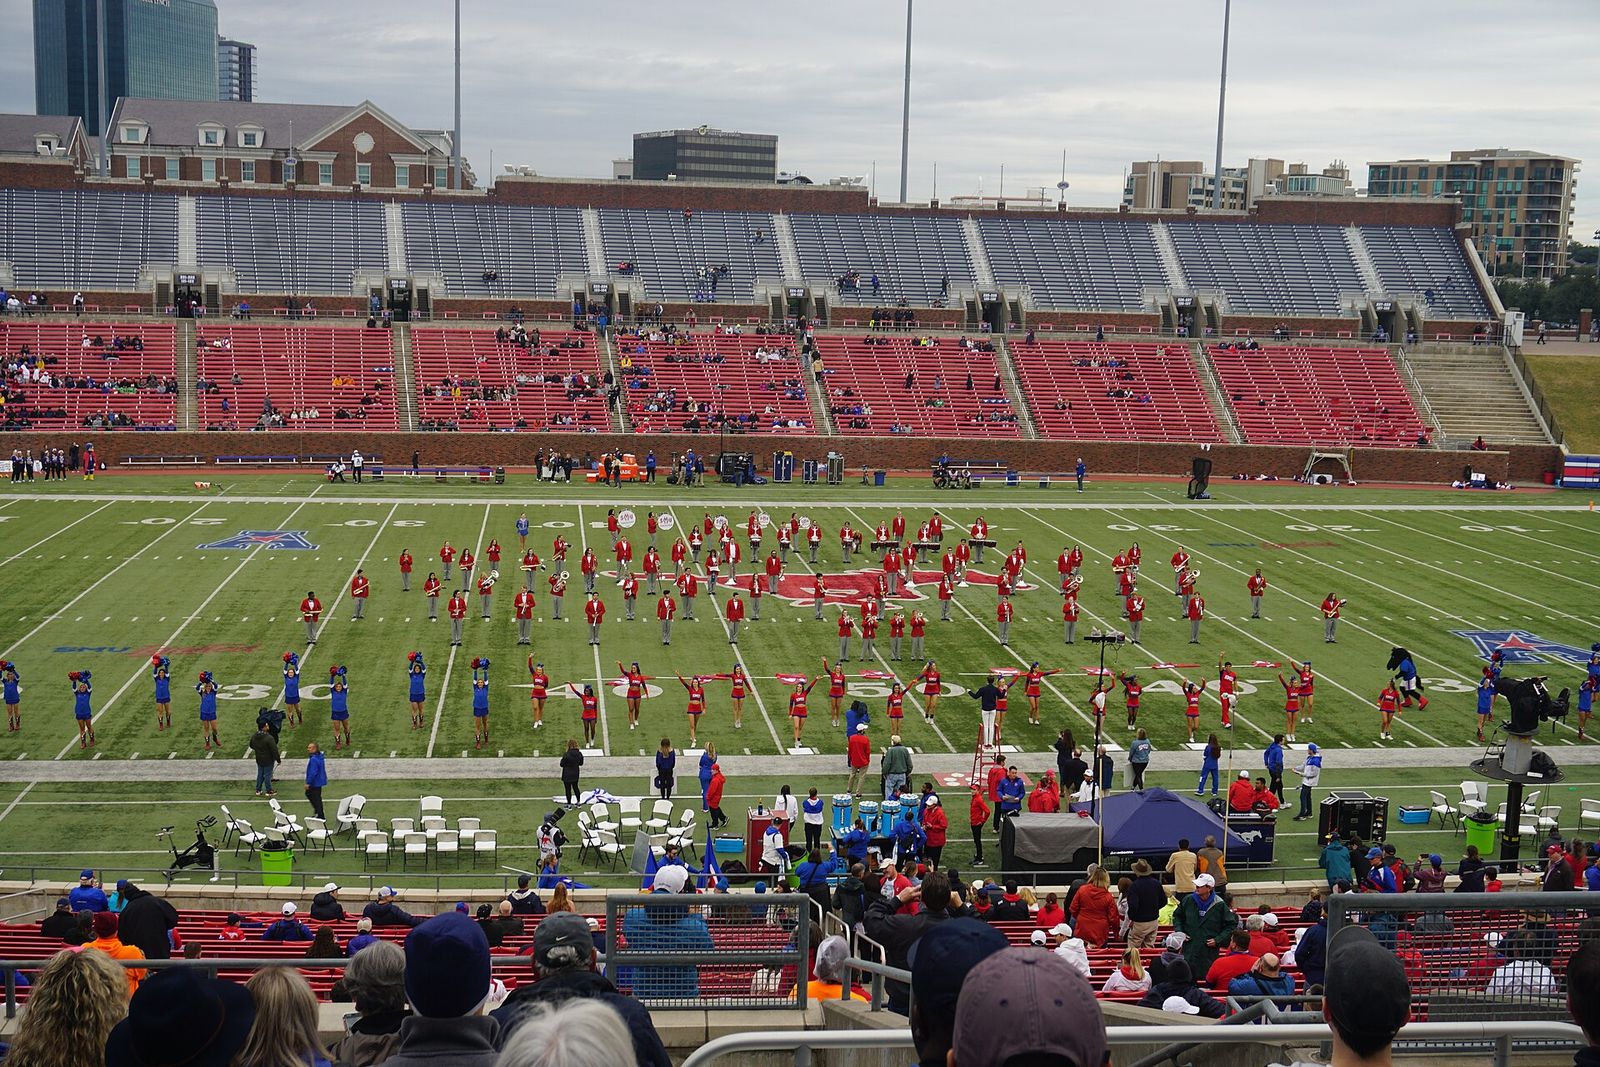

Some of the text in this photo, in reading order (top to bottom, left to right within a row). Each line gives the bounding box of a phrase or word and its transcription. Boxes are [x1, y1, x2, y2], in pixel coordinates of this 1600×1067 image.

[620, 513, 634, 521] SMU
[52, 645, 132, 654] SMU
[216, 684, 334, 700] 30
[847, 682, 966, 698] 50
